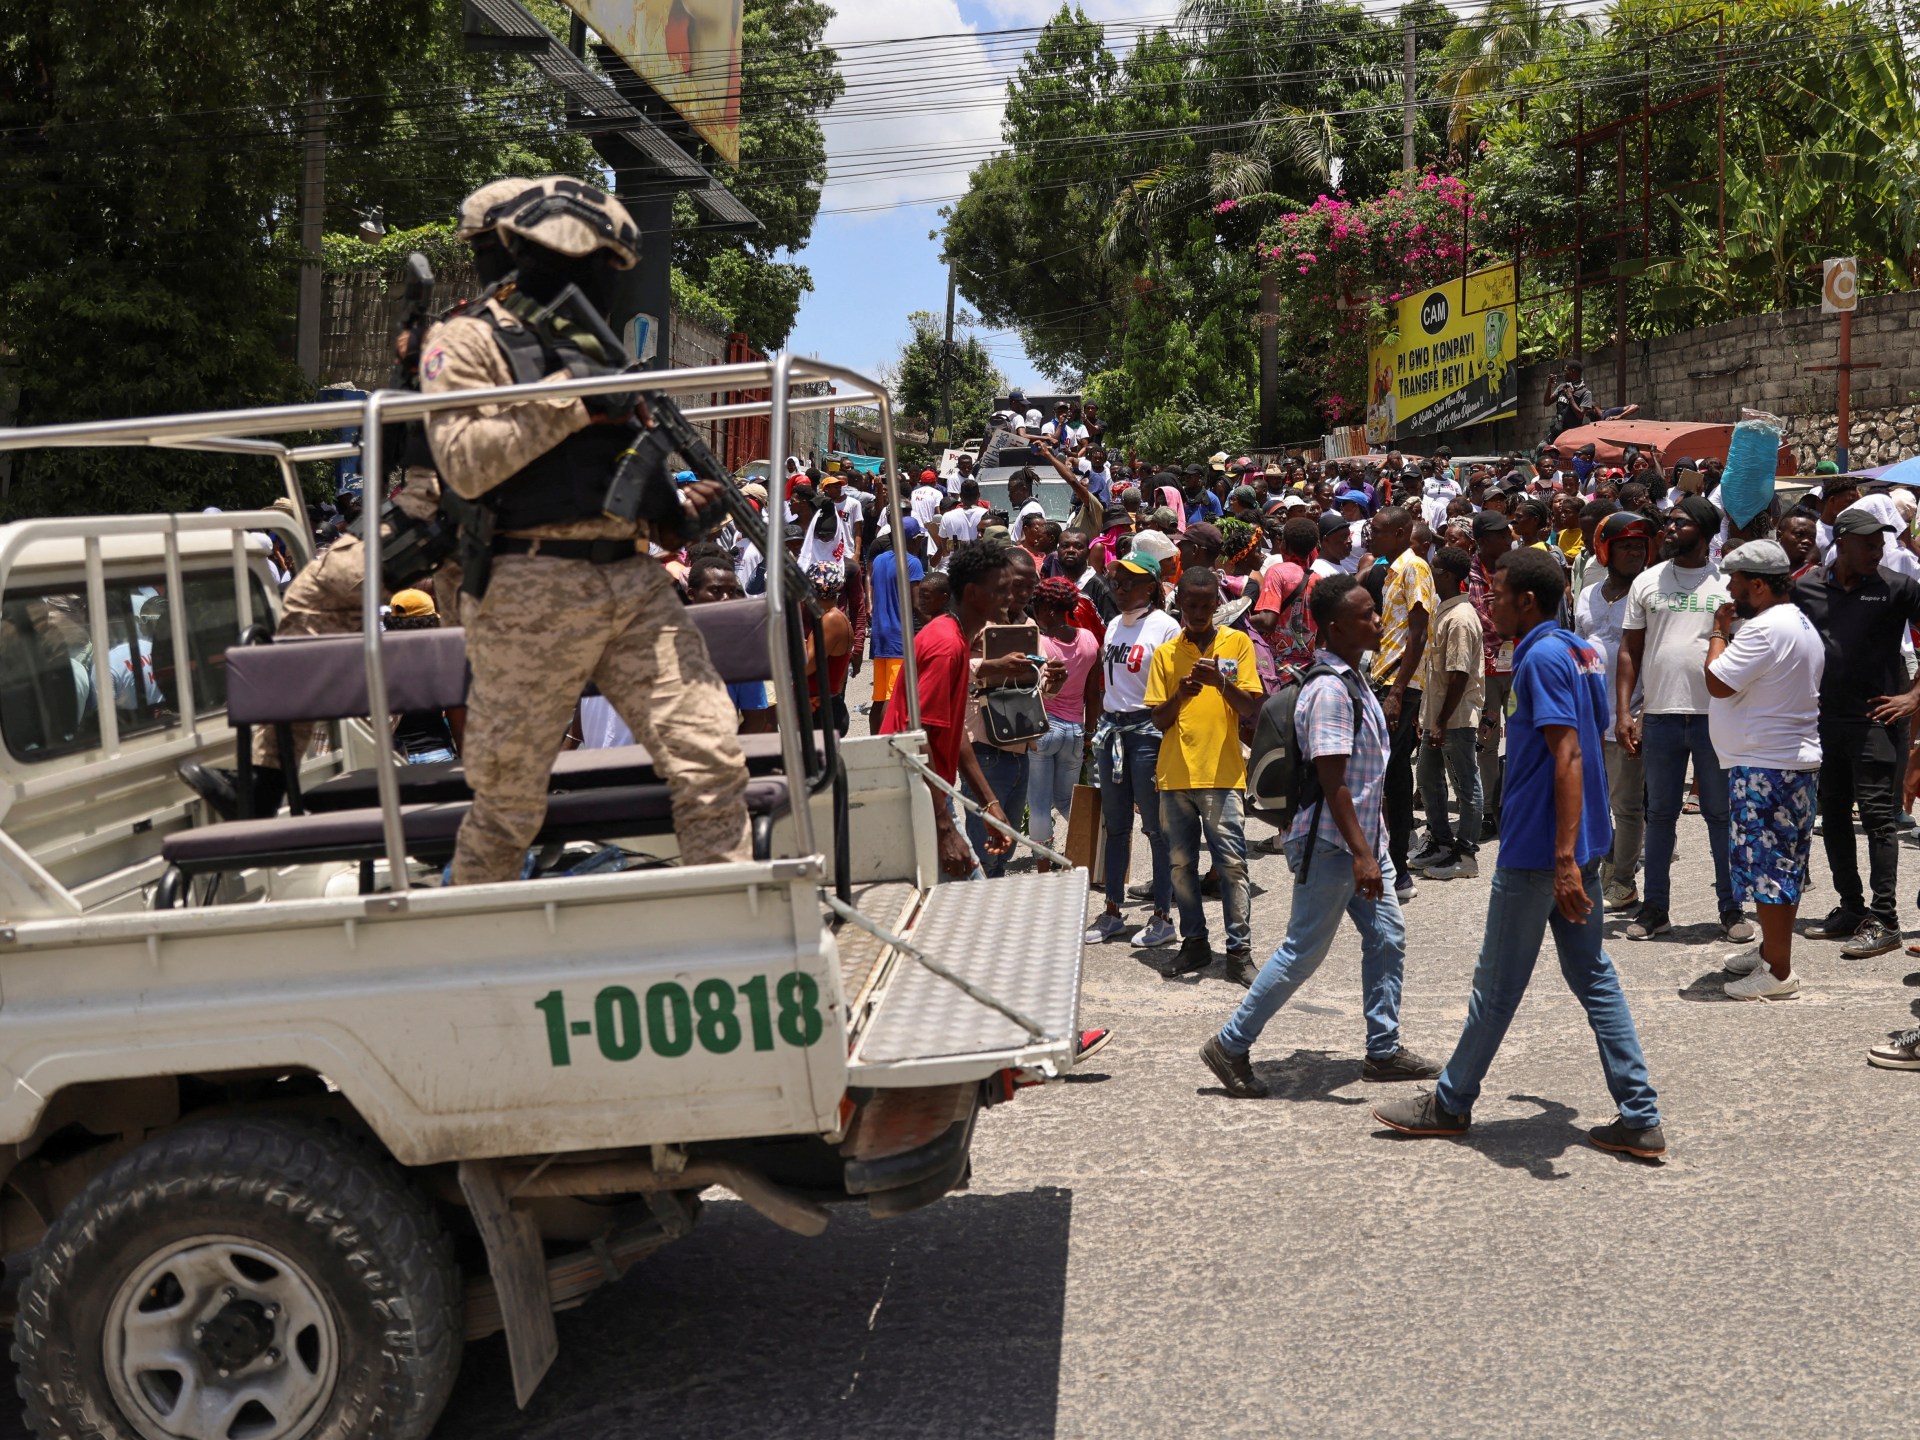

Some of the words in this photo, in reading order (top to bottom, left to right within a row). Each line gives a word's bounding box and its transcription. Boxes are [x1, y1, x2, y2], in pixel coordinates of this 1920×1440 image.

[1423, 301, 1446, 326] CAM
[1397, 352, 1406, 374] PI
[1409, 346, 1430, 371] GWO
[1433, 331, 1475, 365] KONPAYI
[1442, 362, 1465, 389] PEYI
[1468, 360, 1475, 382] A
[1649, 591, 1726, 615] POLO
[534, 971, 824, 1067] 1-00818
